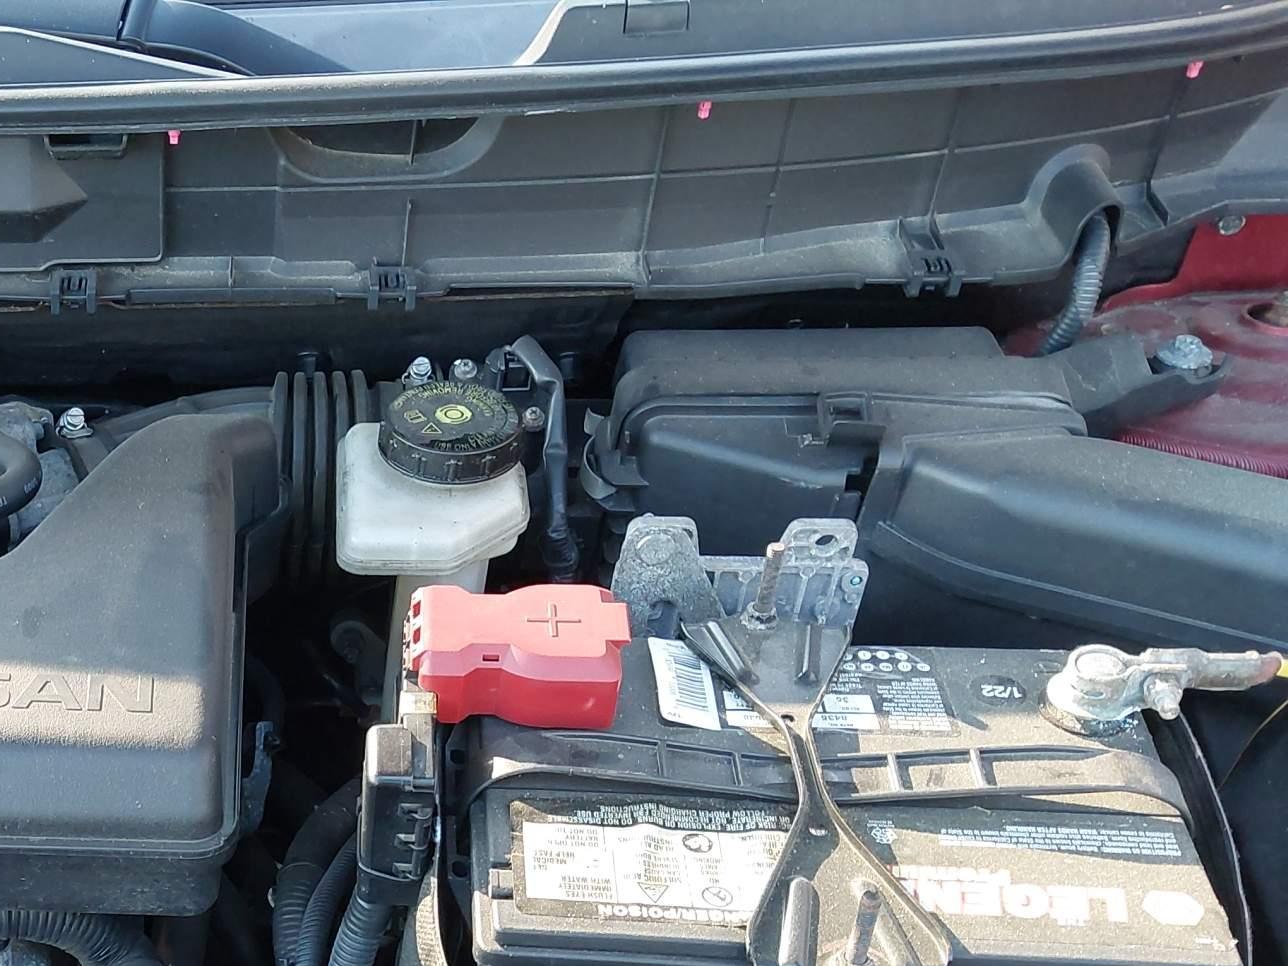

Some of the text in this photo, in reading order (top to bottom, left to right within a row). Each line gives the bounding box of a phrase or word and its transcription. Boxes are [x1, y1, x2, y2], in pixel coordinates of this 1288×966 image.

[980, 684, 1023, 699] 1/22
[658, 804, 696, 816] CHARGING
[593, 811, 629, 819] INVERTED
[664, 820, 676, 828] OR
[678, 822, 721, 831] EXPLOSION
[757, 822, 776, 830] RISK
[561, 876, 588, 884] WATER
